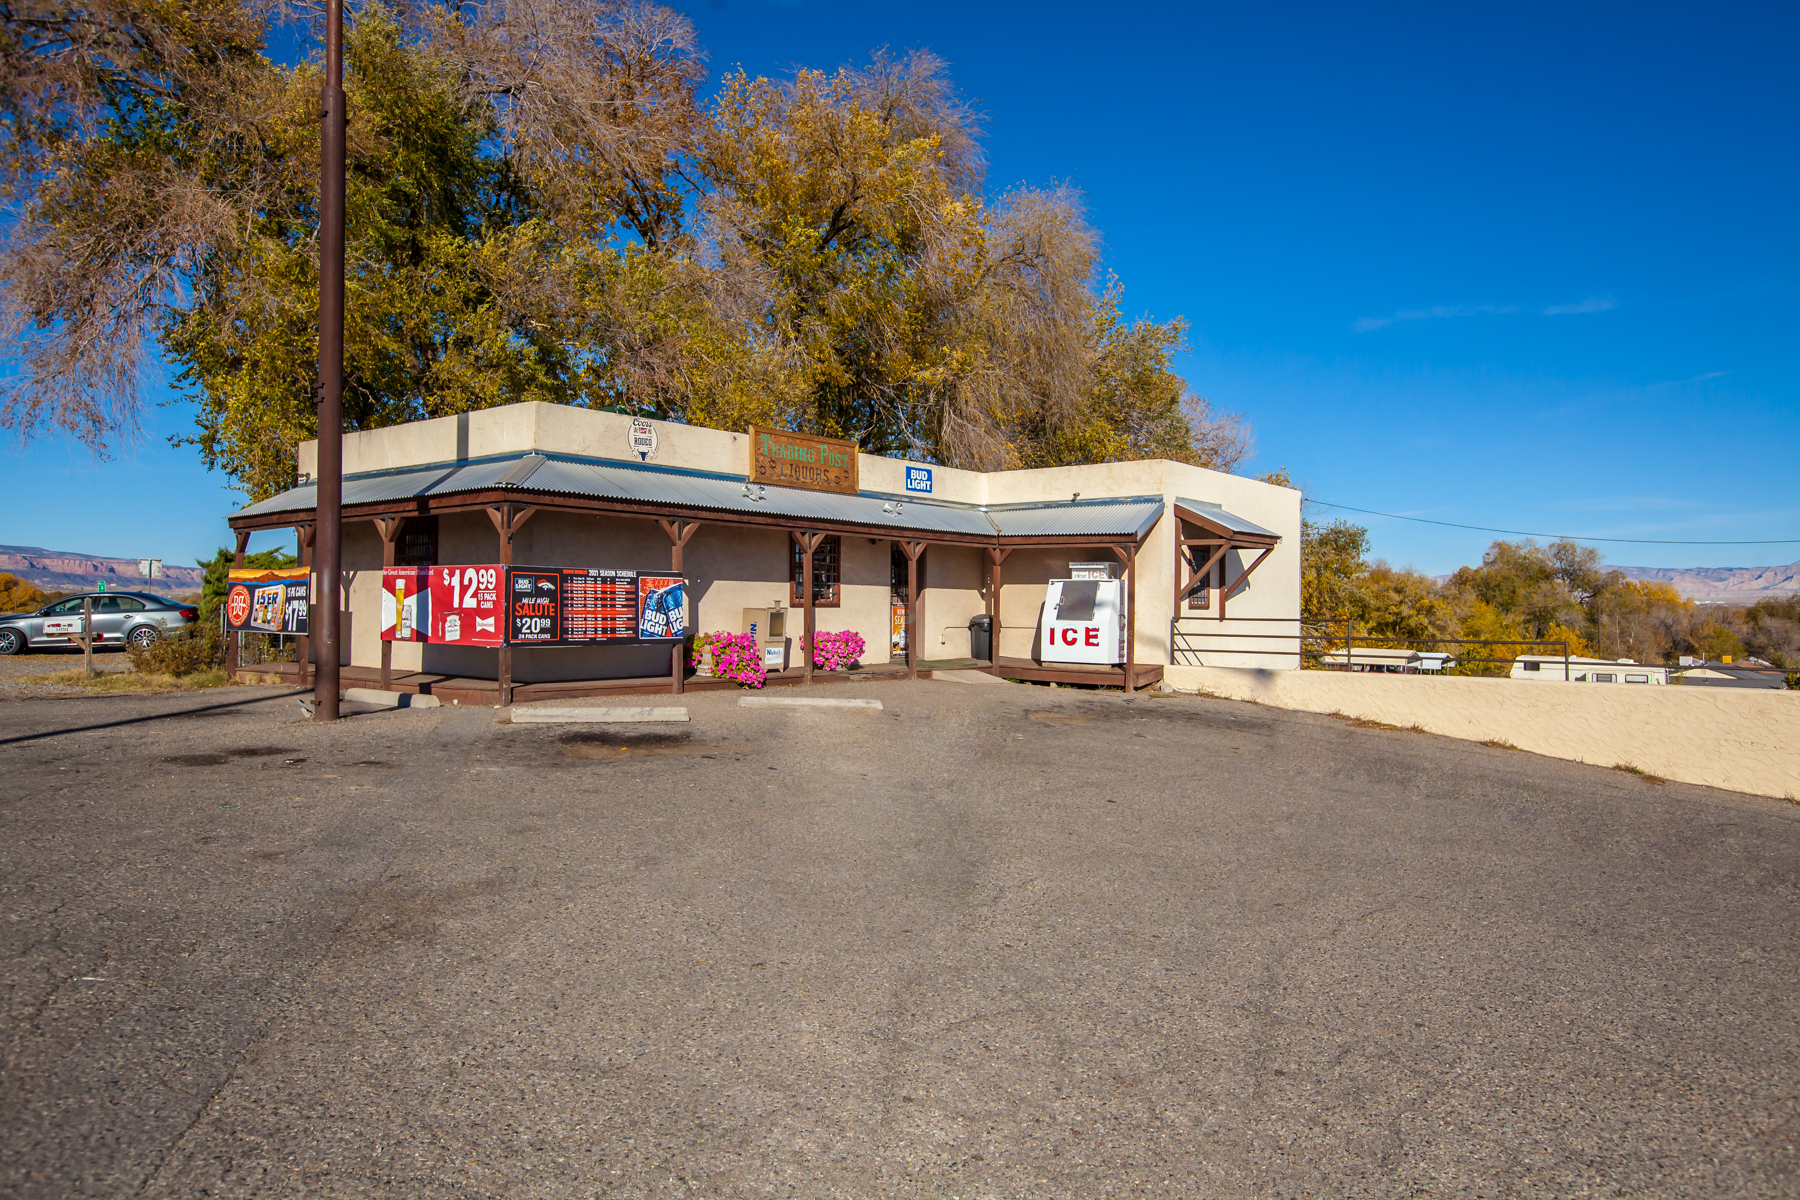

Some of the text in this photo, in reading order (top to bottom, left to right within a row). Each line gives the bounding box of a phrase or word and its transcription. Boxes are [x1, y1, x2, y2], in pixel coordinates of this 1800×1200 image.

[632, 418, 652, 427] Coors
[634, 437, 652, 446] RODEO
[780, 462, 830, 482] LIQUORS
[910, 469, 928, 480] BUD
[908, 479, 931, 491] LIGHT
[515, 603, 555, 616] SALUTE
[669, 606, 683, 622] BU
[645, 610, 667, 625] BUD
[640, 619, 667, 636] LIGHT
[670, 619, 683, 633] LIG
[1050, 626, 1100, 646] ICE
